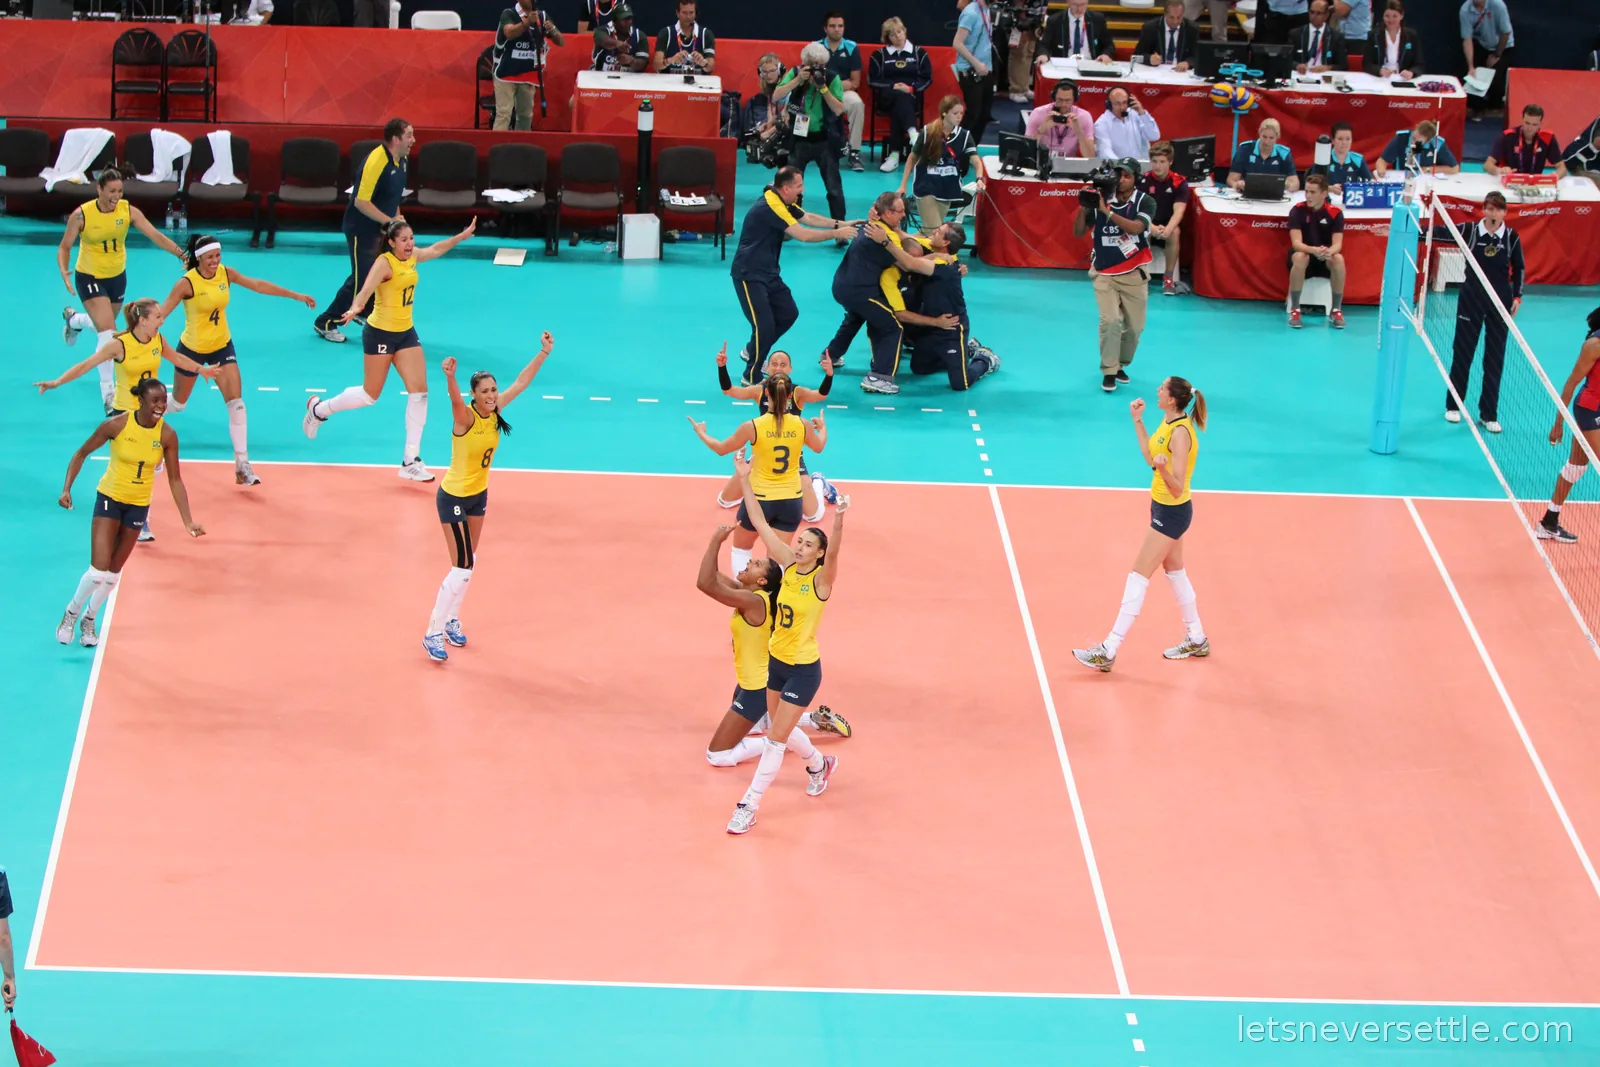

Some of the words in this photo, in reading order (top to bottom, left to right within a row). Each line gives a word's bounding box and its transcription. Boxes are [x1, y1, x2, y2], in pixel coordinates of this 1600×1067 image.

[515, 41, 530, 49] OBS
[1182, 90, 1208, 98] London
[1285, 97, 1311, 105] London
[1388, 100, 1414, 109] London
[1039, 189, 1066, 197] London
[1346, 190, 1364, 206] 25
[1366, 189, 1374, 197] 2
[1378, 188, 1384, 197] 1
[1388, 191, 1404, 206] 17
[1518, 209, 1545, 217] London
[1545, 206, 1562, 214] 2012
[1251, 220, 1279, 228] London
[1343, 223, 1371, 231] London
[102, 238, 117, 253] 11
[87, 283, 99, 294] 11
[402, 285, 415, 307] 12
[209, 308, 220, 326] 4
[377, 344, 388, 354] 12
[481, 447, 494, 468] 8
[772, 445, 790, 474] 3
[136, 461, 145, 479] 1
[103, 500, 109, 511] 1
[453, 505, 461, 516] 8
[777, 602, 794, 629] 13
